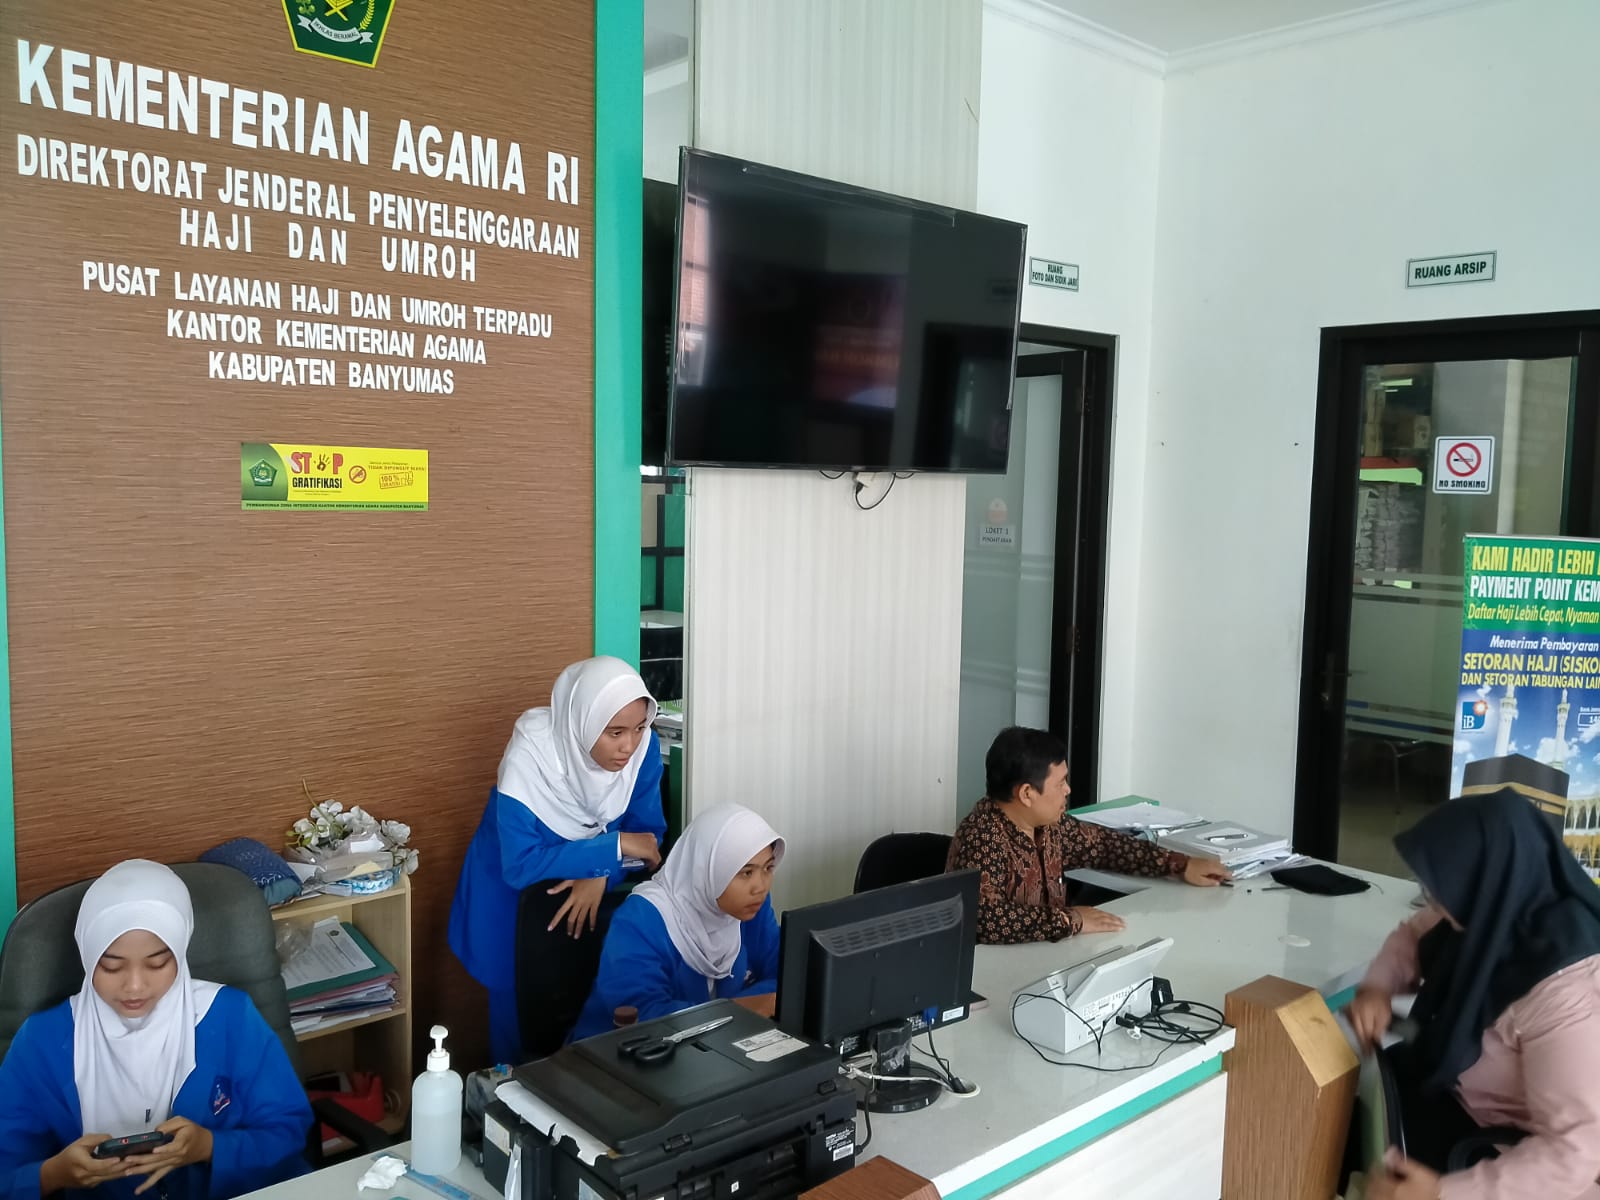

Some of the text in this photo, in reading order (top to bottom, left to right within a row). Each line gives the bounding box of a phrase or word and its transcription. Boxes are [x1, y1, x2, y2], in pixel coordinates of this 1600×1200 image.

[18, 39, 579, 206] KEMENTERIAN AGAMA RI
[17, 133, 580, 259] DIREKTORAT JENDERAL PENYELENGGARAAN
[180, 207, 477, 282] HAJI DAN UMROH
[1414, 260, 1487, 279] RUANG ARSIP
[82, 260, 553, 339] PUSAT LAYANAN HAJI DAN UMROH TERPADU
[166, 308, 487, 365] KANTOR KEMENTERIAN AGAMA
[208, 351, 455, 395] KABUPATEN BANYUMAS
[292, 477, 343, 489] GRATIFIKASI
[1438, 479, 1486, 489] NO SMOKING
[1472, 545, 1509, 571] KAMI
[1511, 547, 1554, 573] HADIR
[1557, 549, 1595, 575] LEBIH
[1470, 575, 1531, 599] PAYMENT
[1534, 577, 1572, 600] POINT
[1467, 602, 1497, 619] Daftar
[1496, 604, 1515, 624] Haji
[1514, 604, 1539, 621] Lebih
[1565, 606, 1600, 627] Nyaman
[1489, 634, 1599, 654] Menerima Pembayaran
[1463, 652, 1600, 674] SETORAN HAJI (SISKO
[1461, 672, 1482, 685] DAN
[1483, 673, 1530, 687] SETORAN
[1530, 674, 1583, 689] TABUNGAN
